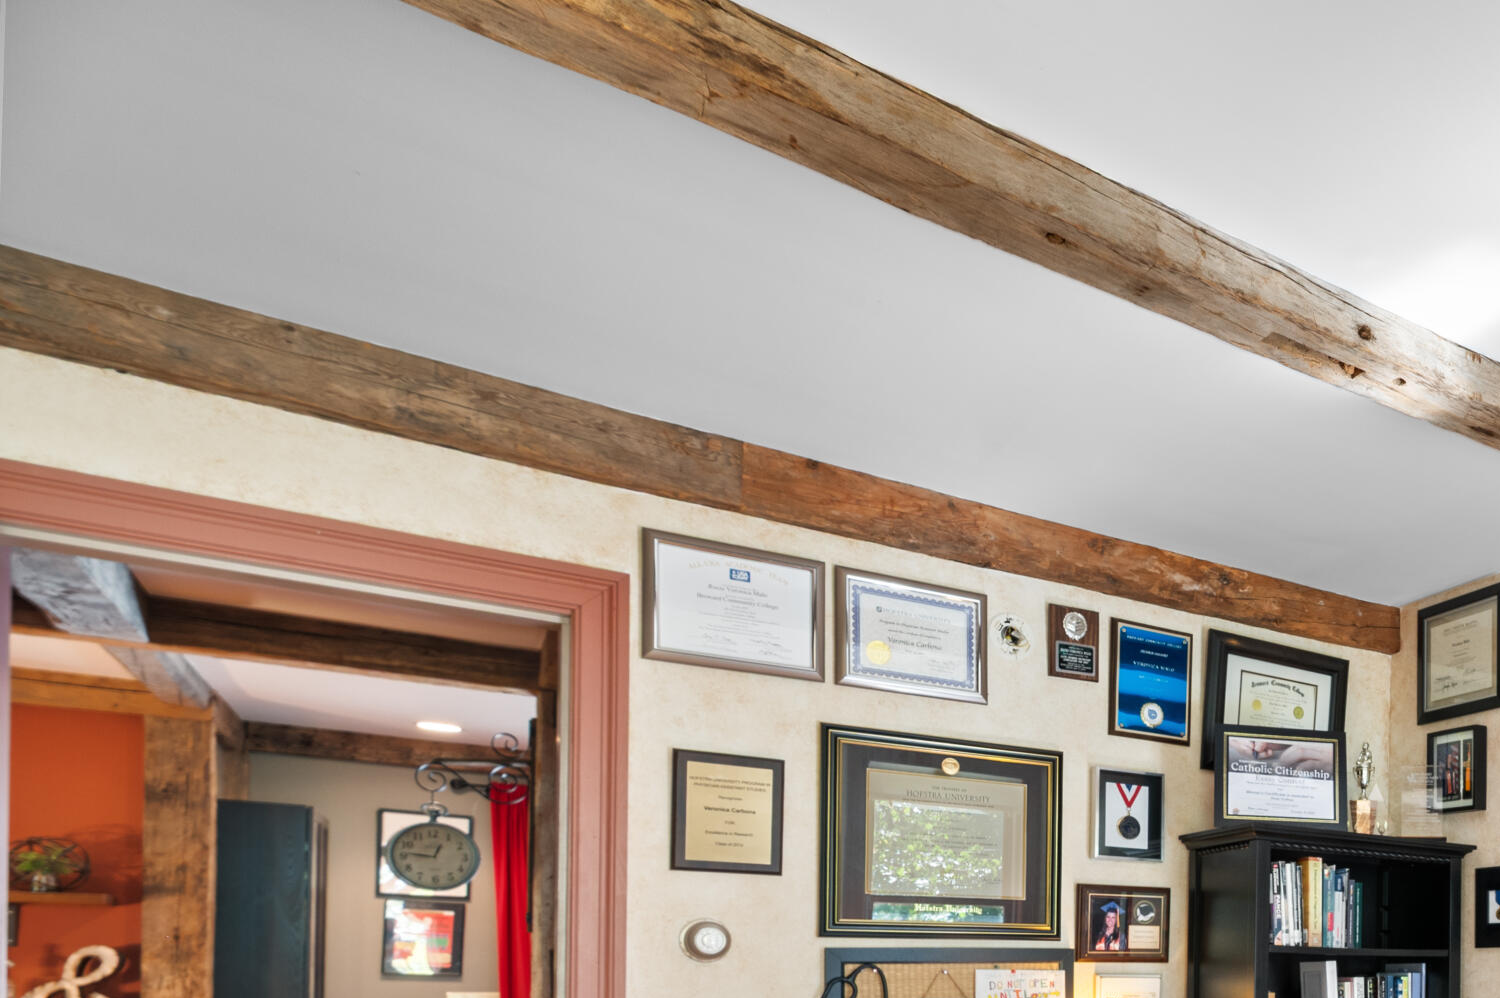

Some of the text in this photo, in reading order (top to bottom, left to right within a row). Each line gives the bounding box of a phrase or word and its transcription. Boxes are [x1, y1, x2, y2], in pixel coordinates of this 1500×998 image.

[1231, 761, 1330, 781] Catholic Citizenship
[989, 978, 1055, 990] DO NOT OPEN
